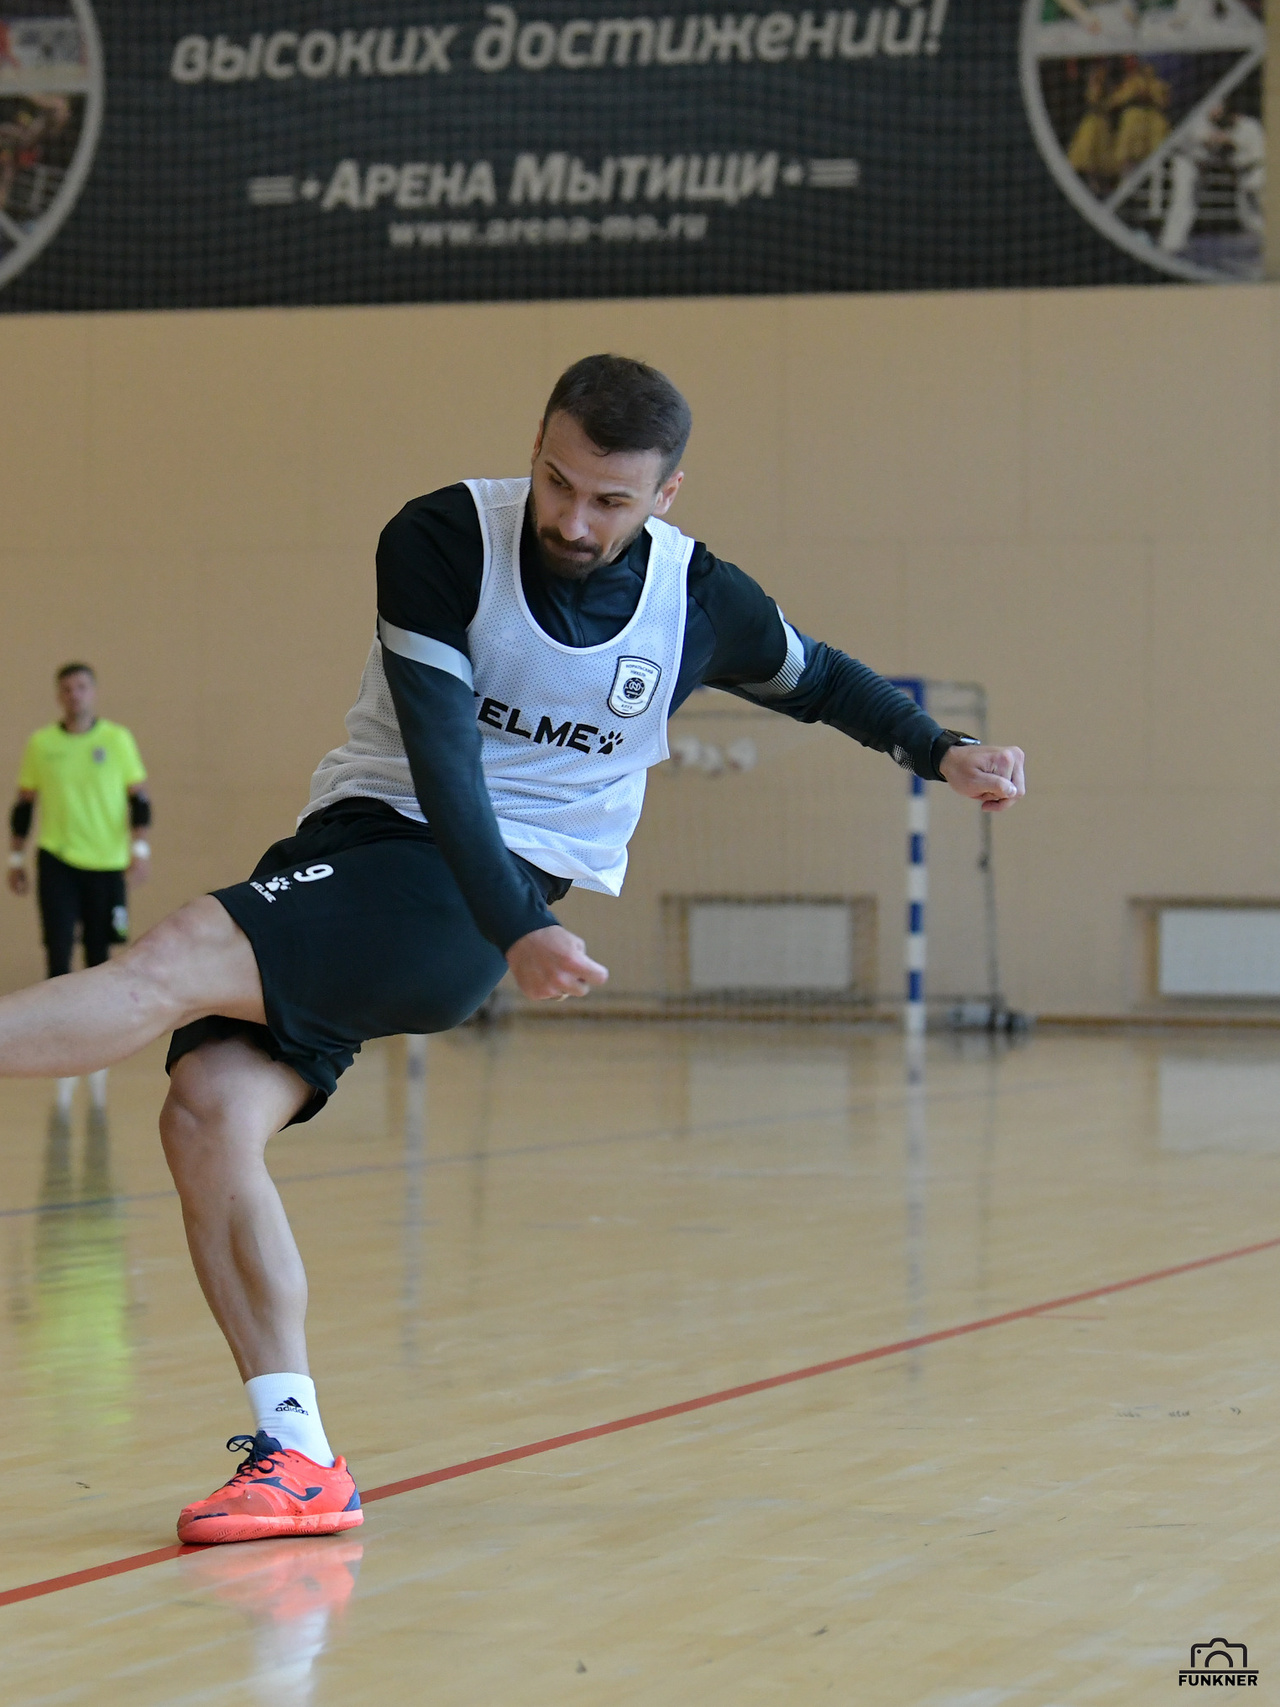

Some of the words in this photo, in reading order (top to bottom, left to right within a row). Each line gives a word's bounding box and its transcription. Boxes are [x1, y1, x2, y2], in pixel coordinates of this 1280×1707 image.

[172, 24, 457, 83] высоких
[472, 0, 948, 72] достижений!
[474, 690, 599, 754] ELME
[293, 863, 334, 882] 9
